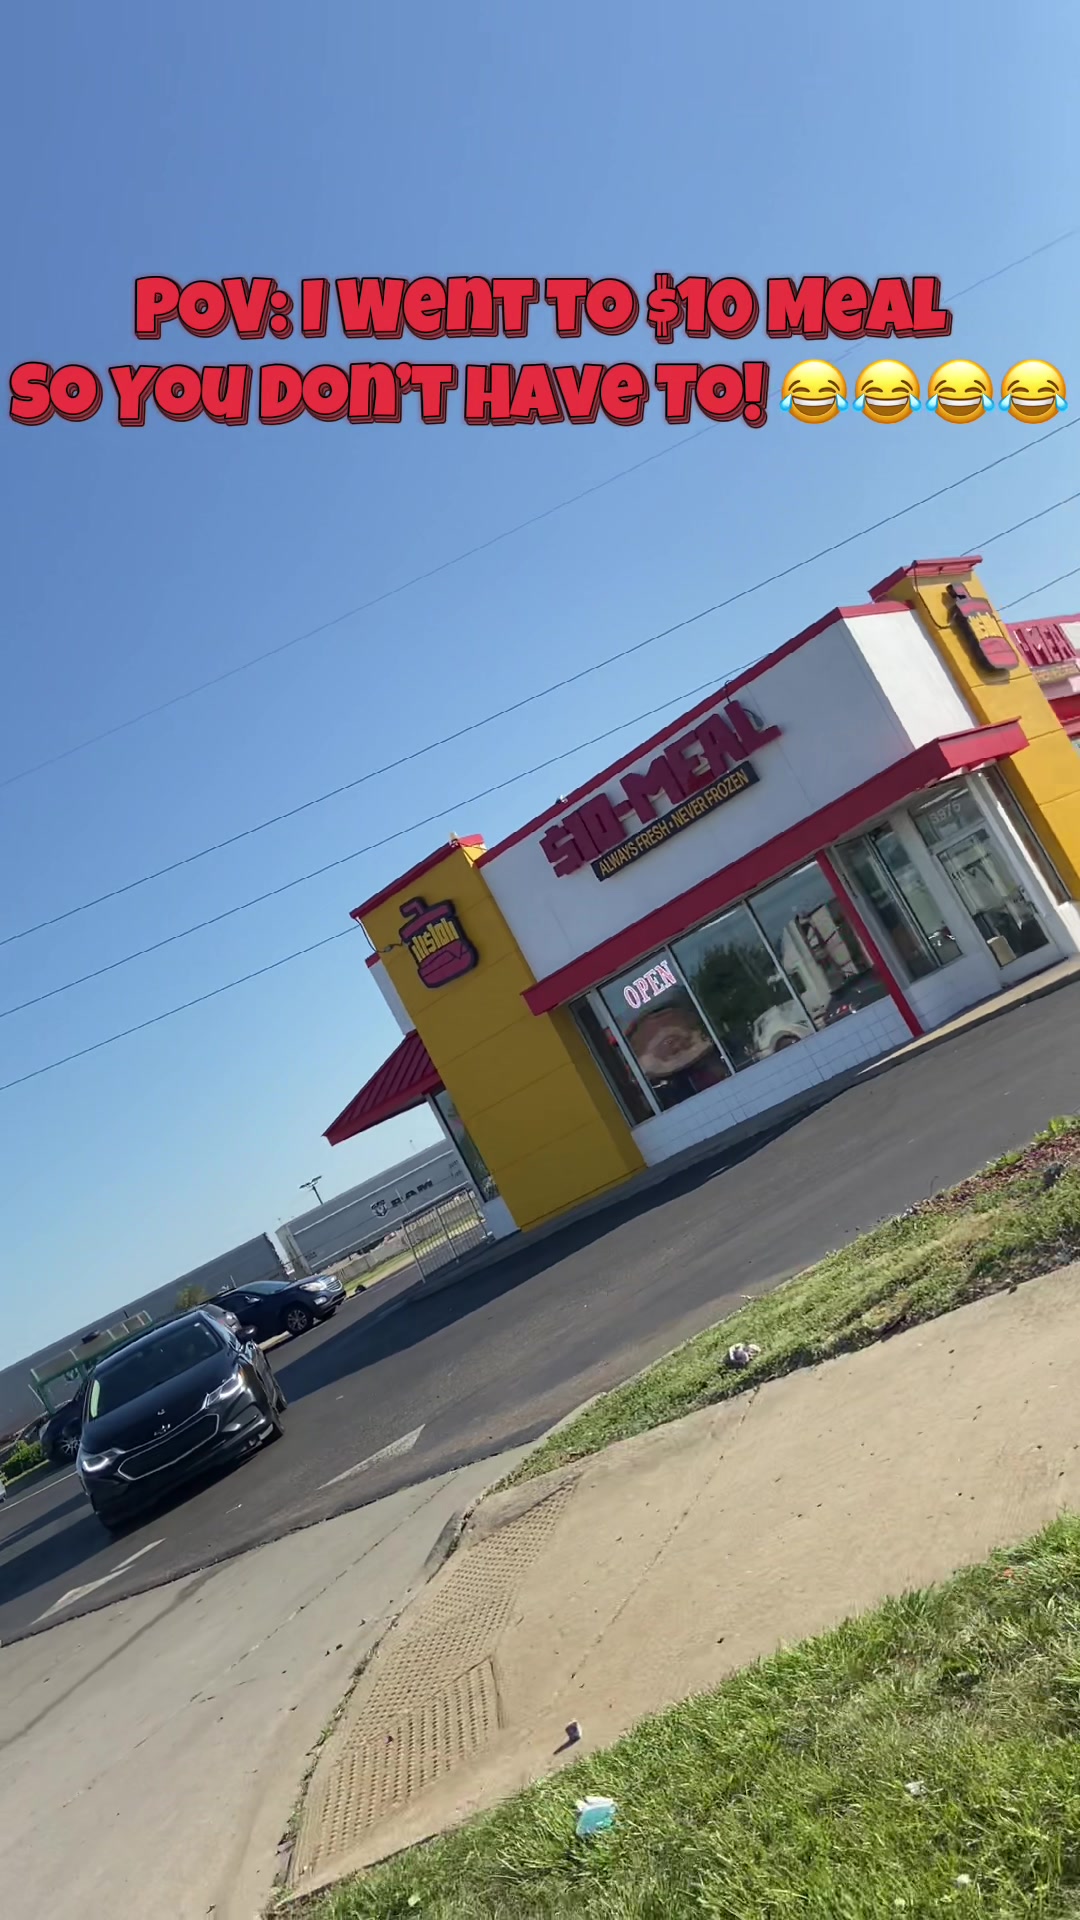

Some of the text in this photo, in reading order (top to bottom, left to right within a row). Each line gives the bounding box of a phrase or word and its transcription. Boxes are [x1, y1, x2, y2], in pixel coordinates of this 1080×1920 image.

[539, 699, 782, 878] $10-MEAL
[599, 768, 750, 876] ALWAYS FRESH NEVER FROZEN
[623, 960, 677, 1009] OPEN
[390, 1179, 434, 1208] RAM
